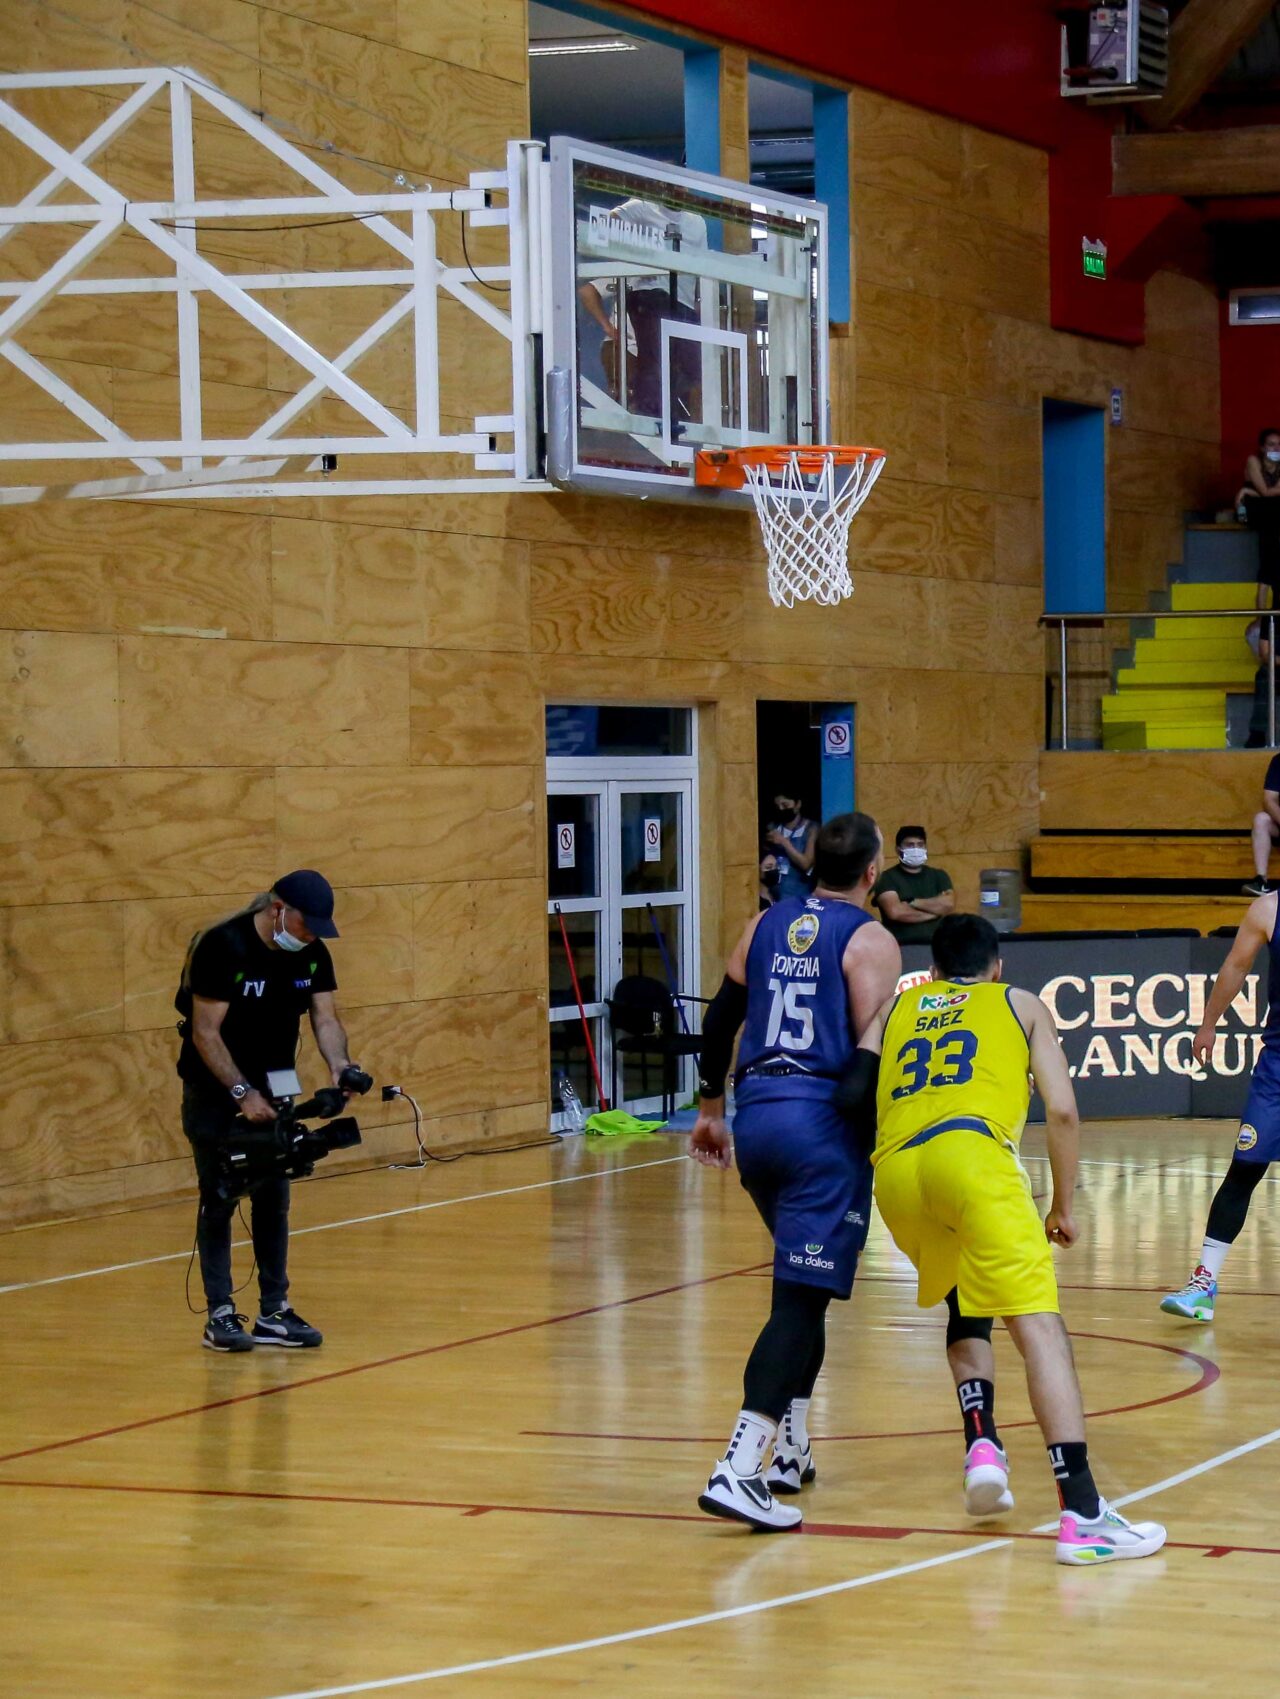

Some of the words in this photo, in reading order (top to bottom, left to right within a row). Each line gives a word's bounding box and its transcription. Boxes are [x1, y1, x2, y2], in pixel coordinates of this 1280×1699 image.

[764, 978, 817, 1051] 15
[914, 1009, 965, 1032] SAEZ
[1039, 974, 1270, 1030] CECIN
[890, 1030, 979, 1101] 33
